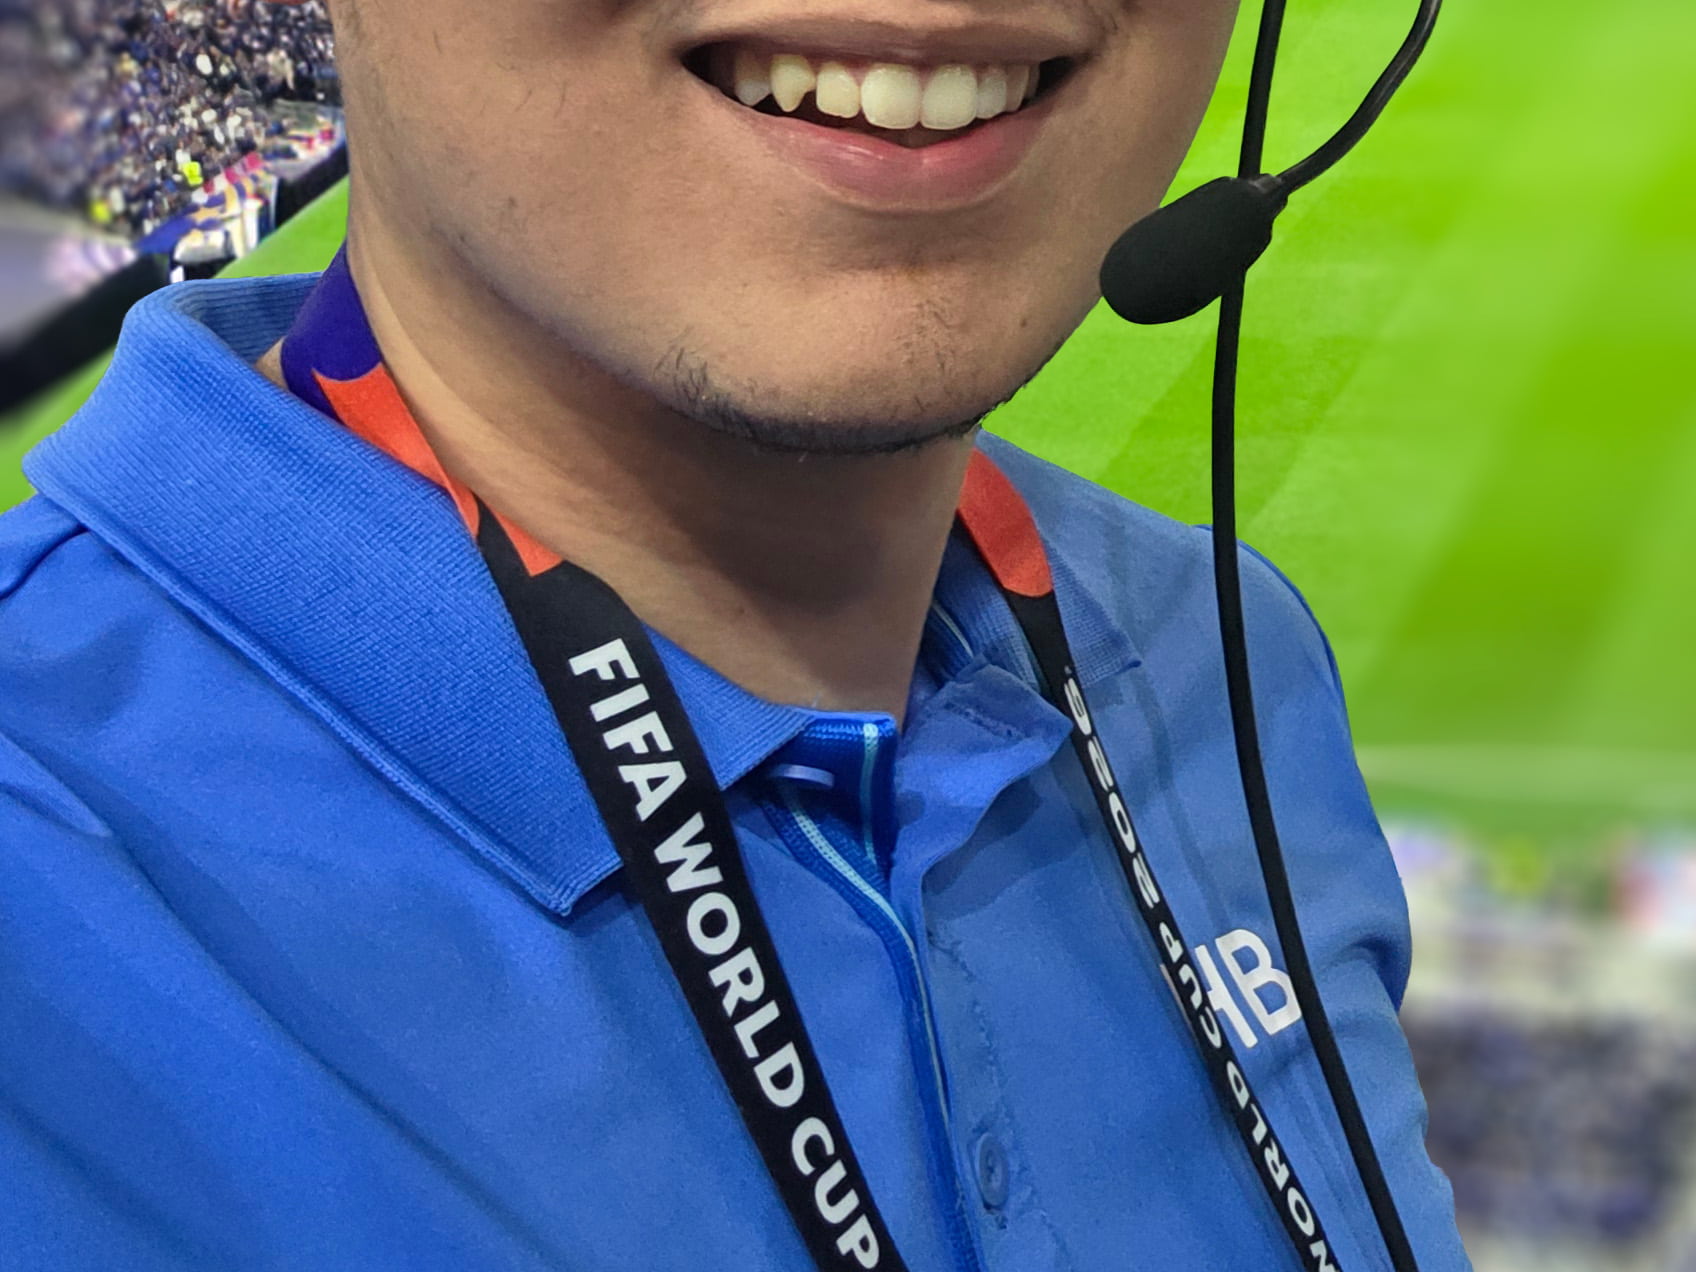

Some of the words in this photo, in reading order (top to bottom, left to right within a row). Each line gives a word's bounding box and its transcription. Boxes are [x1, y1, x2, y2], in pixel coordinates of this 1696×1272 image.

[1064, 677, 1160, 909] 2026
[568, 638, 688, 822] FIFA
[654, 812, 804, 1108] WORLD
[790, 1116, 880, 1269] CUP
[1159, 922, 1222, 1048] CUP
